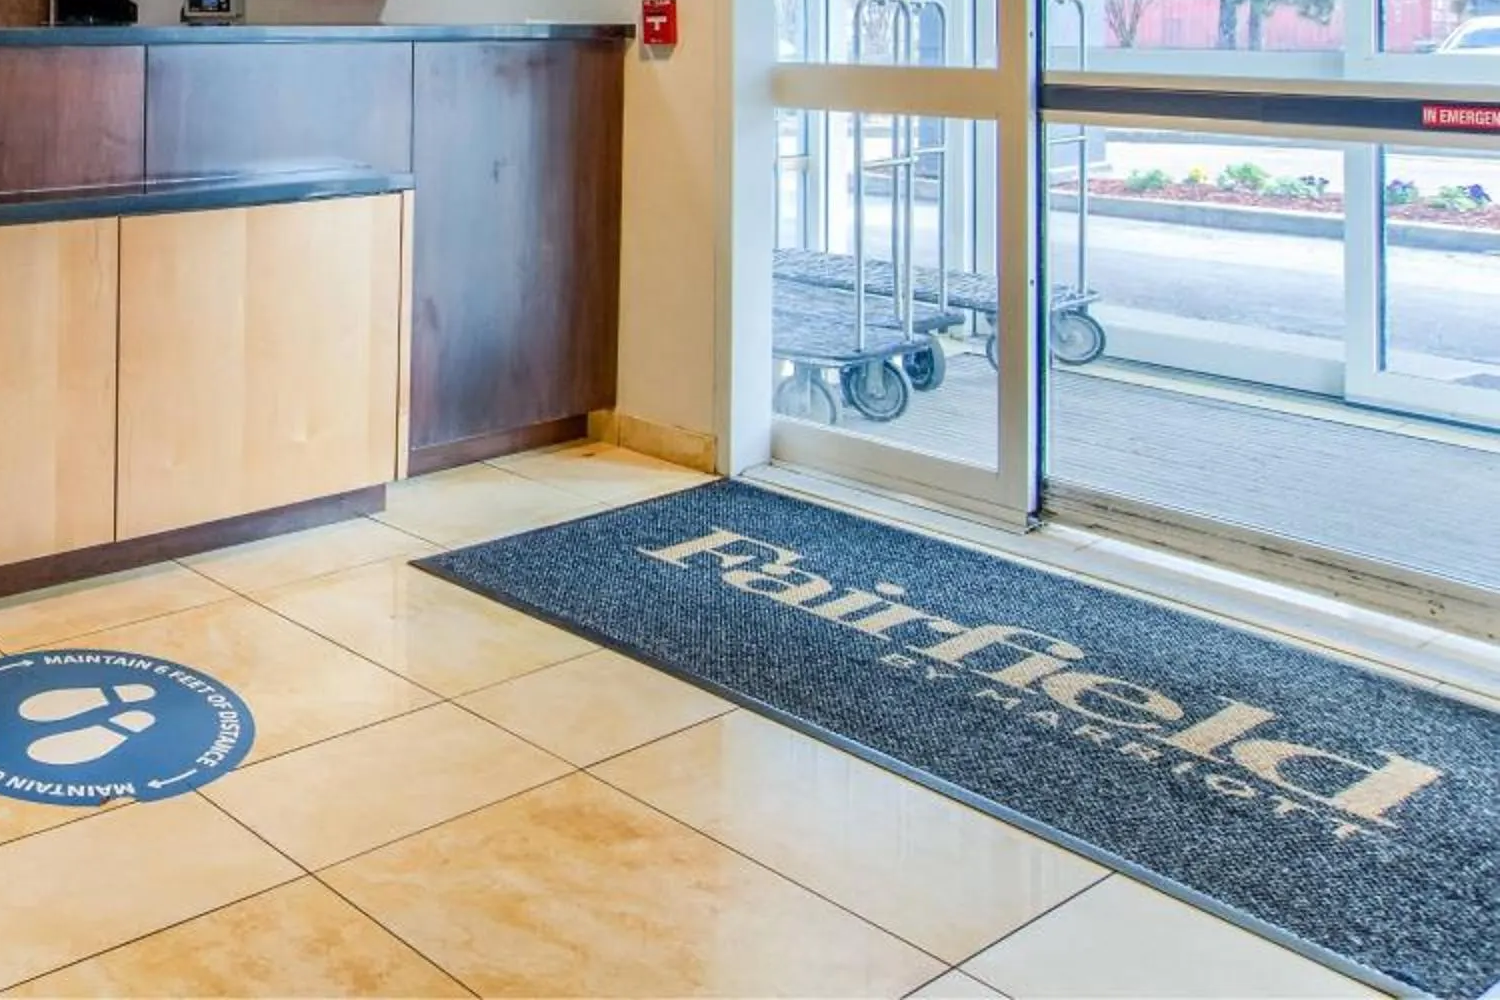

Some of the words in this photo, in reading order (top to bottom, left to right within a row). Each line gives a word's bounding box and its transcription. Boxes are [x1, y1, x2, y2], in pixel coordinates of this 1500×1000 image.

[1422, 105, 1438, 126] IN
[43, 654, 152, 671] MAINTAIN
[153, 664, 171, 675] 6
[169, 670, 215, 694] FEET
[636, 525, 1443, 828] Fairfield
[207, 693, 232, 710] OF
[195, 709, 241, 768] DISTANCE
[5, 774, 136, 797] MAINTAIN
